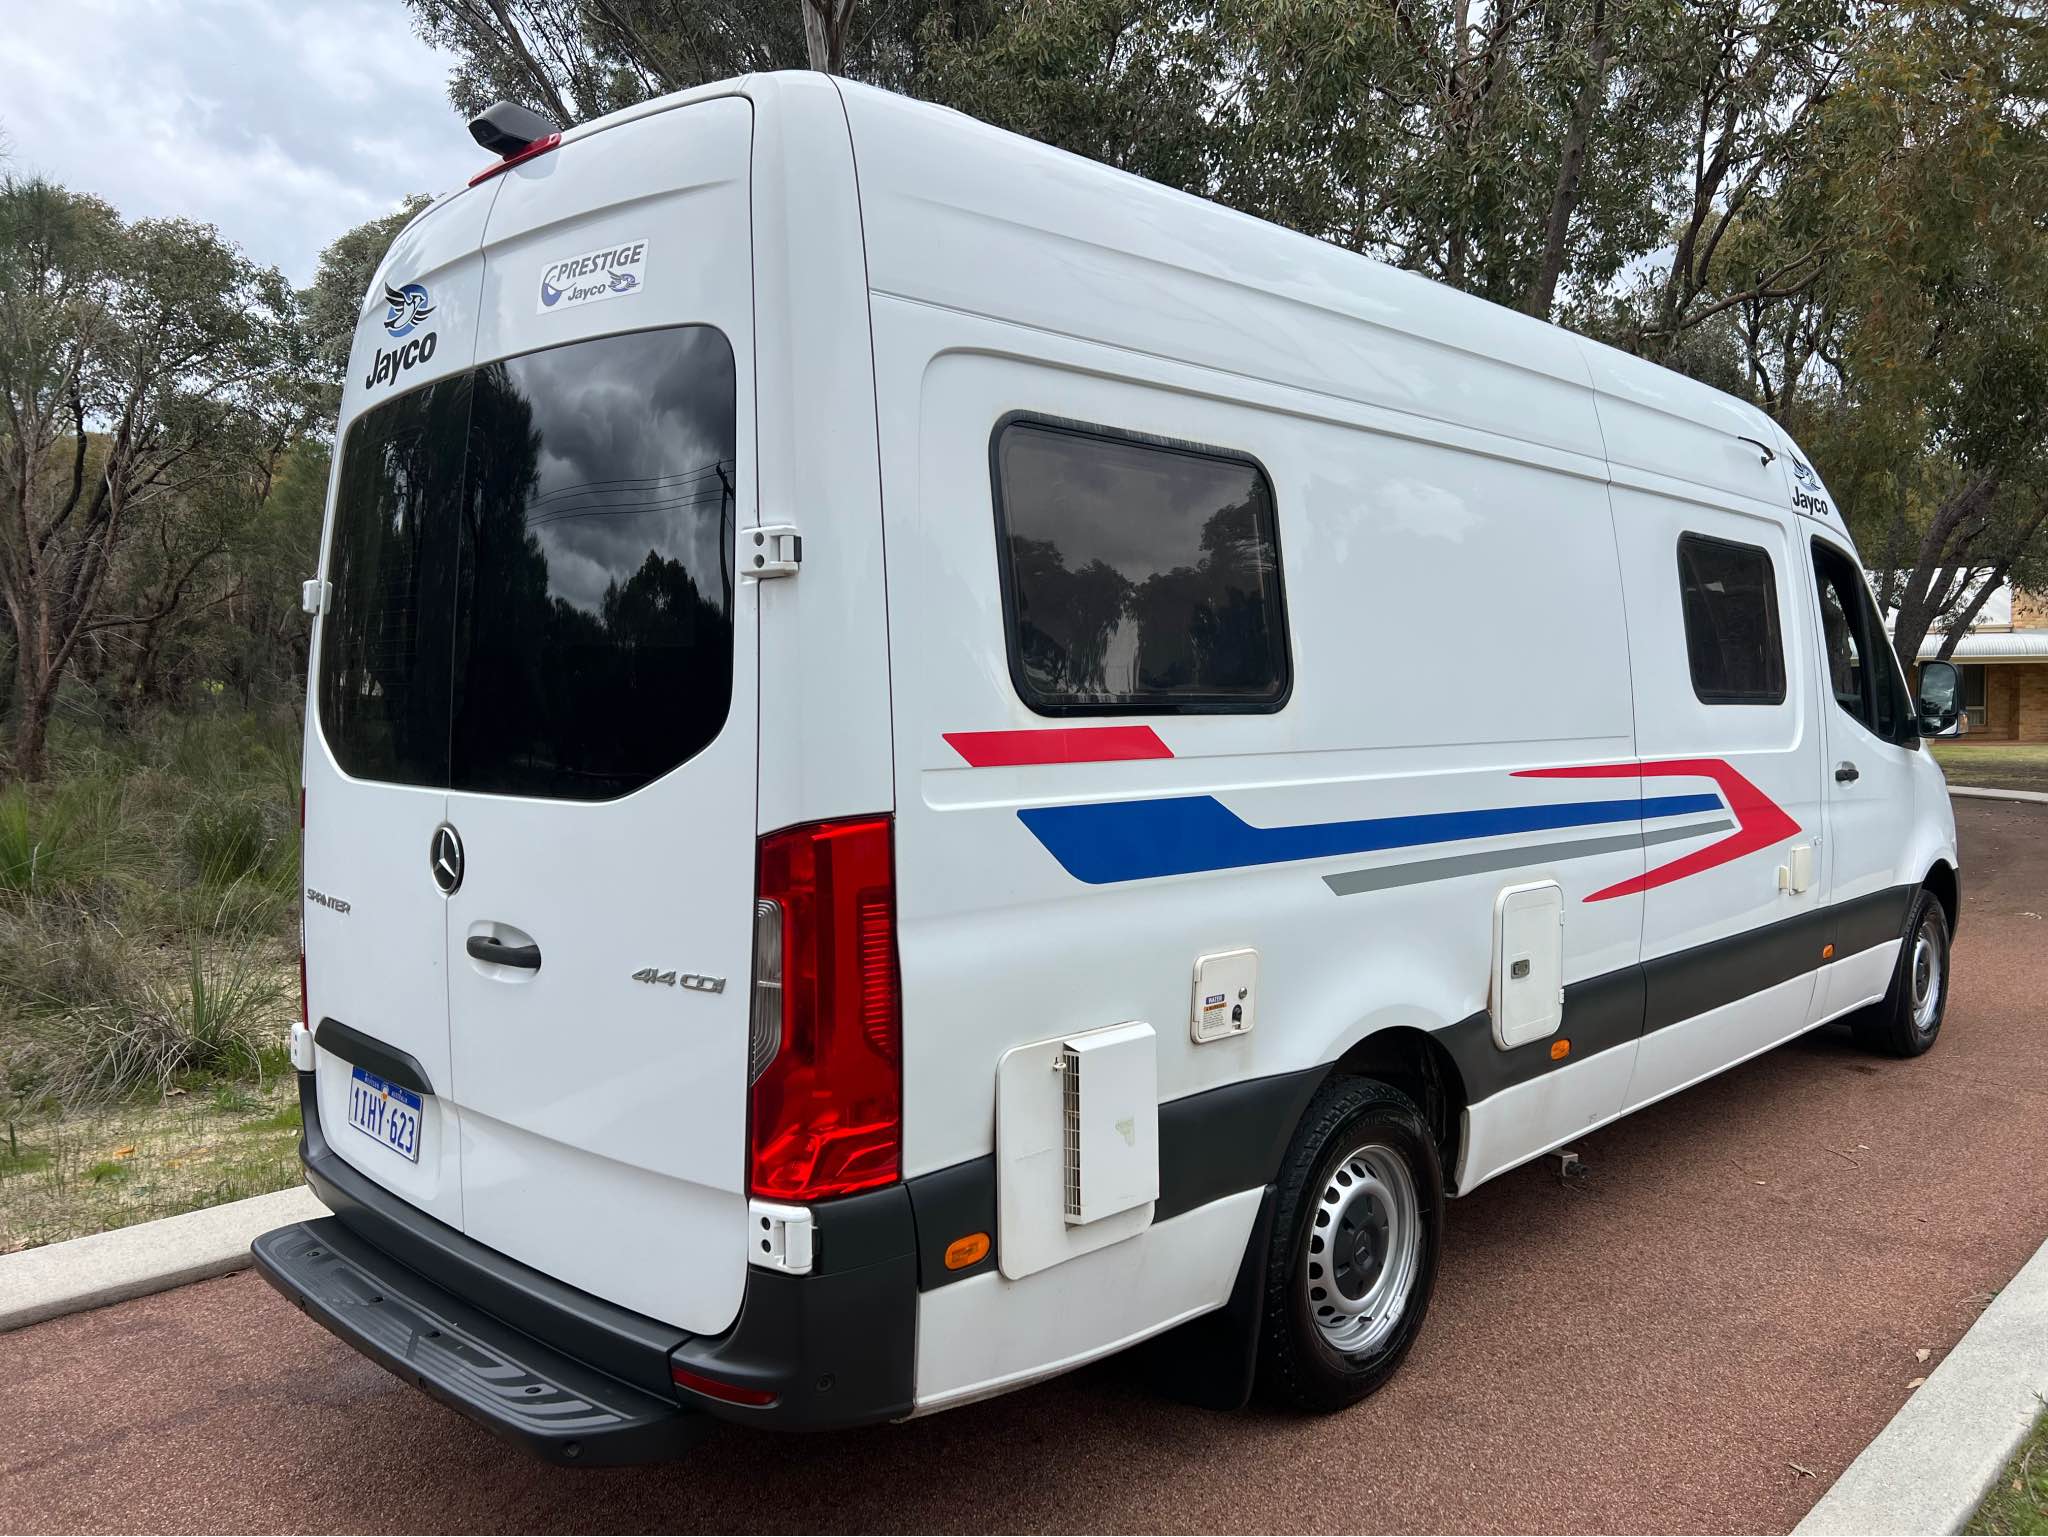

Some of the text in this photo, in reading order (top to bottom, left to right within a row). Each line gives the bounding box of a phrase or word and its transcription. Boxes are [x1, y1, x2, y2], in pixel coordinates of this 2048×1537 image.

[557, 244, 644, 282] PRESTIGE
[568, 284, 606, 301] Jayco
[365, 331, 438, 390] Jayco
[1792, 486, 1828, 515] Jayco
[306, 888, 351, 914] SPRINTER
[631, 967, 727, 994] 414 CDI
